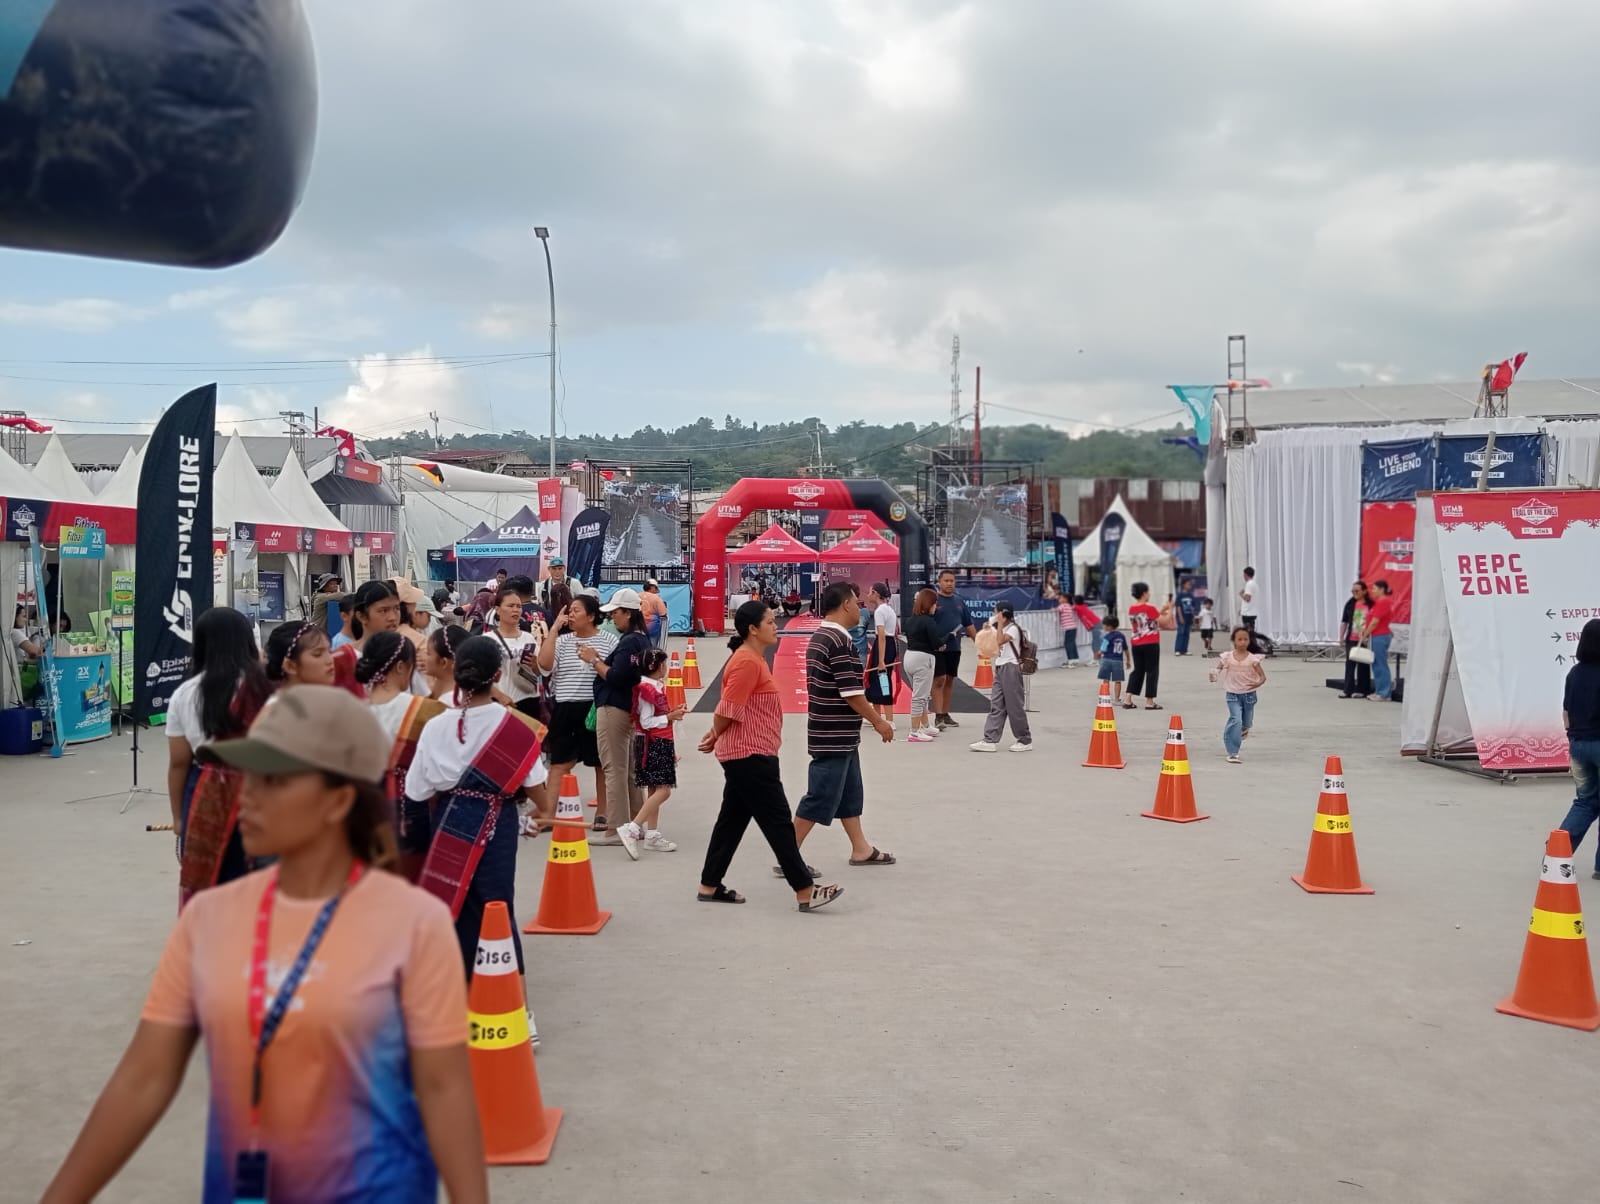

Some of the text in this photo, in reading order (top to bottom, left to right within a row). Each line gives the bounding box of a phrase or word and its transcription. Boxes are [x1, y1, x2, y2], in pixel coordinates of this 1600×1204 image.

[1379, 452, 1417, 469] LIVE YOUR
[1384, 457, 1422, 478] LEGEND
[718, 505, 741, 513] UTMB
[1513, 508, 1526, 516] TRAIL
[1544, 508, 1557, 516] KINGS
[577, 522, 600, 534] UTMB
[1458, 553, 1523, 574] REPC
[1459, 574, 1530, 595] ZONE
[1561, 608, 1589, 618] EXPO
[1113, 642, 1123, 654] 10
[78, 667, 89, 676] 2X
[565, 804, 580, 812] ISG
[560, 849, 577, 857] ISG
[486, 951, 512, 964] ISG
[481, 1027, 508, 1040] ISG
